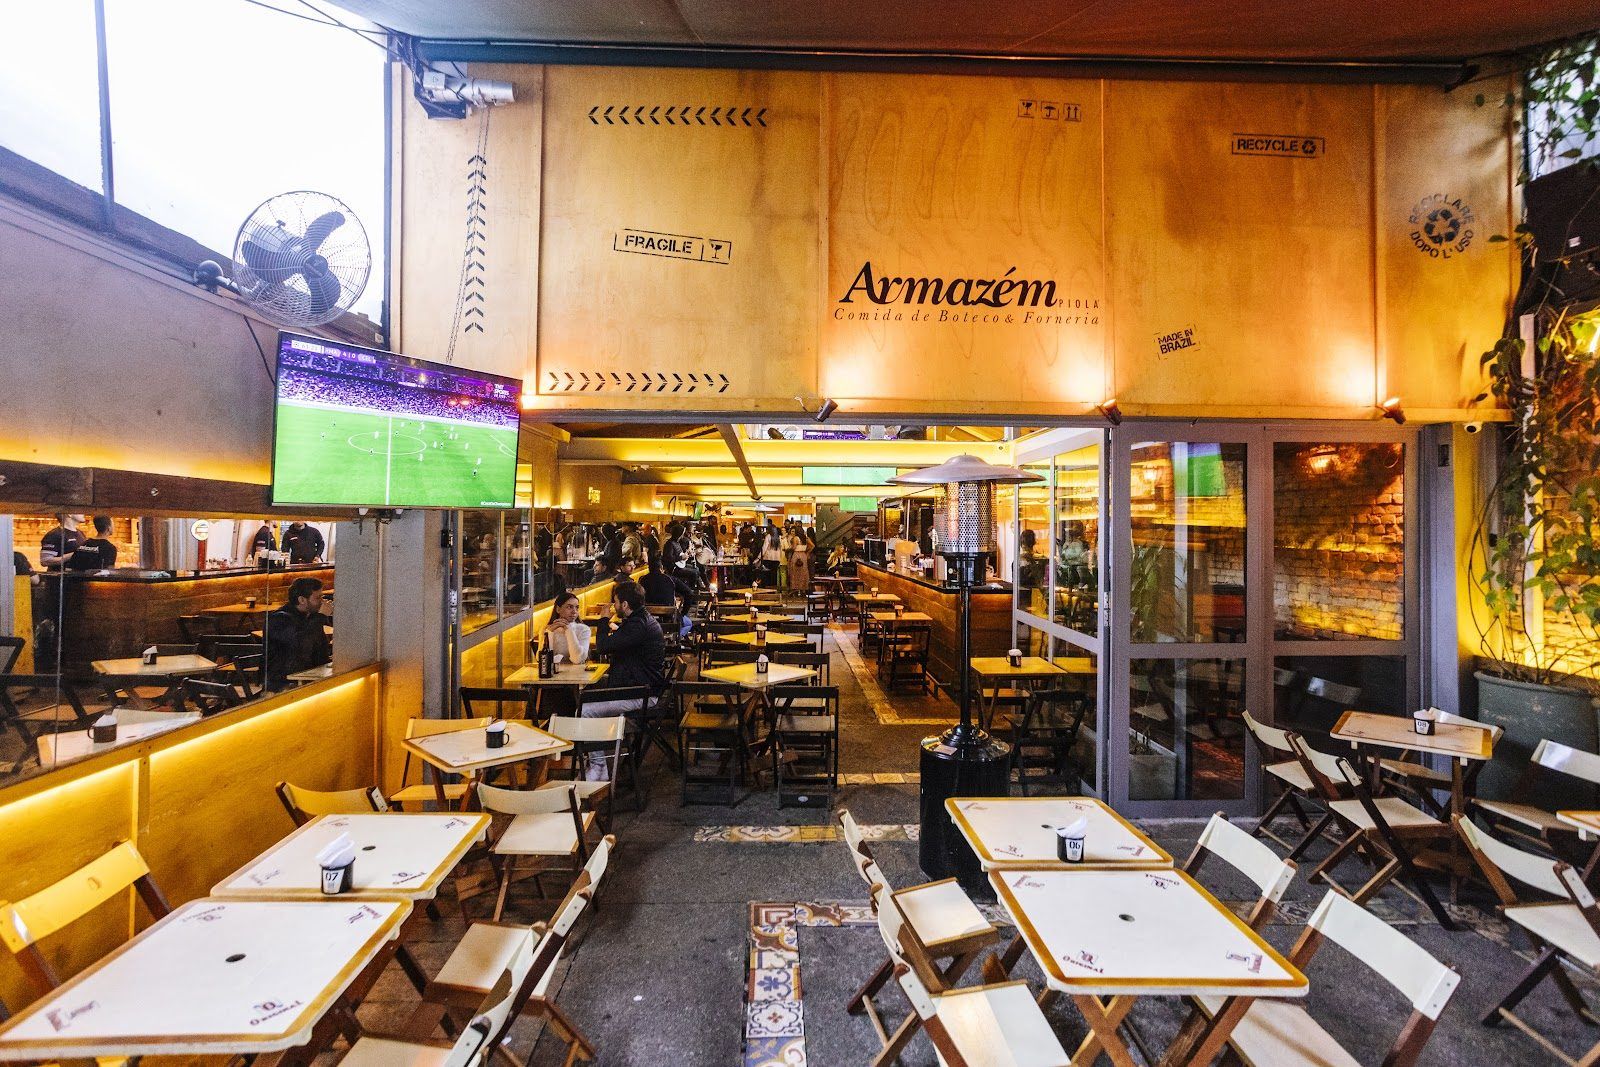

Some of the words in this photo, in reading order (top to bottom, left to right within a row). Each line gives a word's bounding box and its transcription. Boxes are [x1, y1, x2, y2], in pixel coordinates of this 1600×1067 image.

[1237, 138, 1299, 152] RECYCLE
[624, 234, 693, 254] FRAGILE
[1410, 231, 1439, 258] DOPO
[838, 261, 1058, 308] Armazém
[834, 307, 903, 321] Comida
[911, 309, 930, 321] de
[938, 309, 999, 323] Boteco
[1023, 311, 1100, 325] Forneria
[1157, 331, 1183, 344] MADE
[1184, 328, 1193, 337] IN
[1160, 337, 1196, 354] BRAZIL
[1069, 841, 1081, 850] 06
[324, 872, 339, 881] 07
